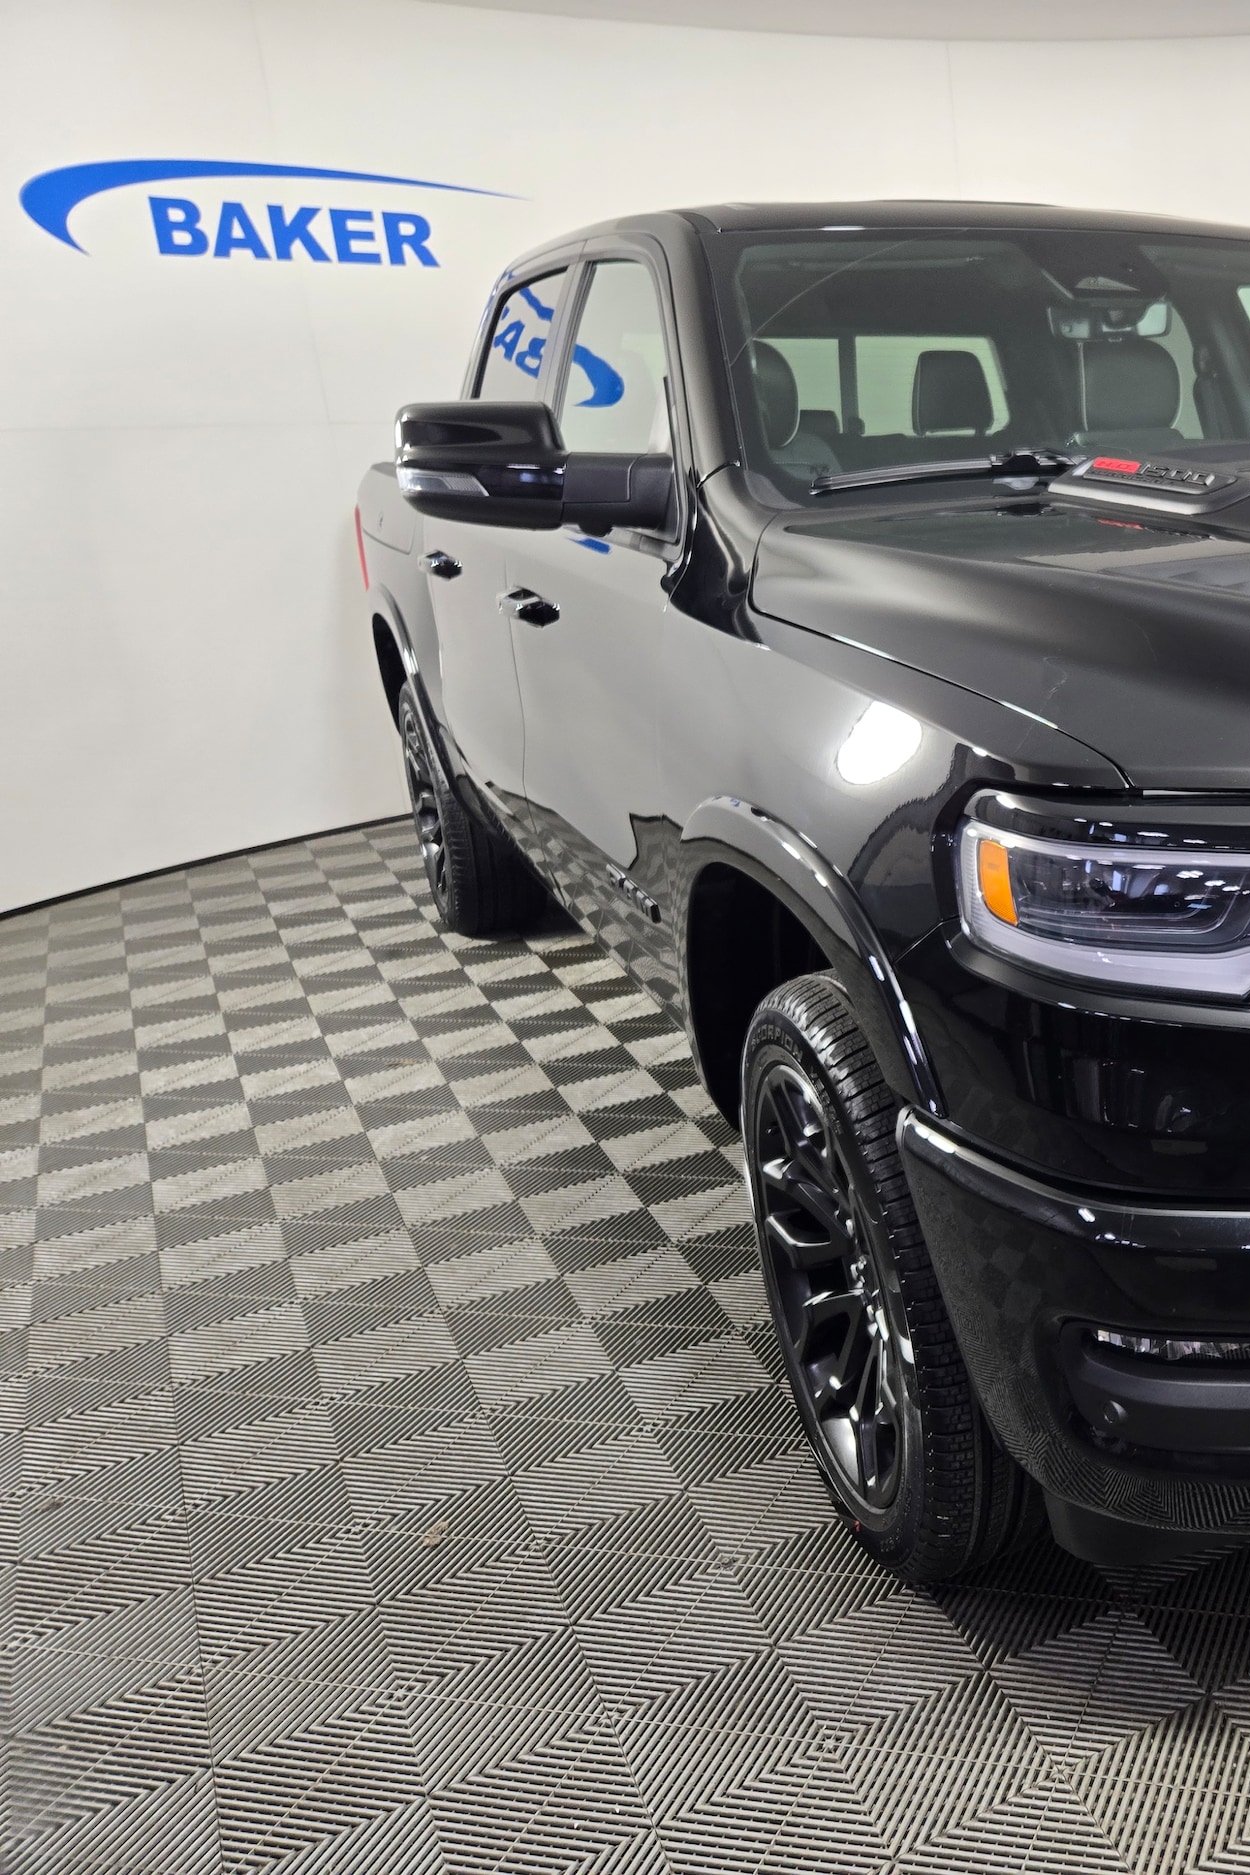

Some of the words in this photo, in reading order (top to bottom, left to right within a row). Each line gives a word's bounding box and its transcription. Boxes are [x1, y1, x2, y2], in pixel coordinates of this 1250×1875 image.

[148, 195, 440, 268] BAKER
[1140, 462, 1216, 487] 1500
[751, 1024, 804, 1064] SCORPION
